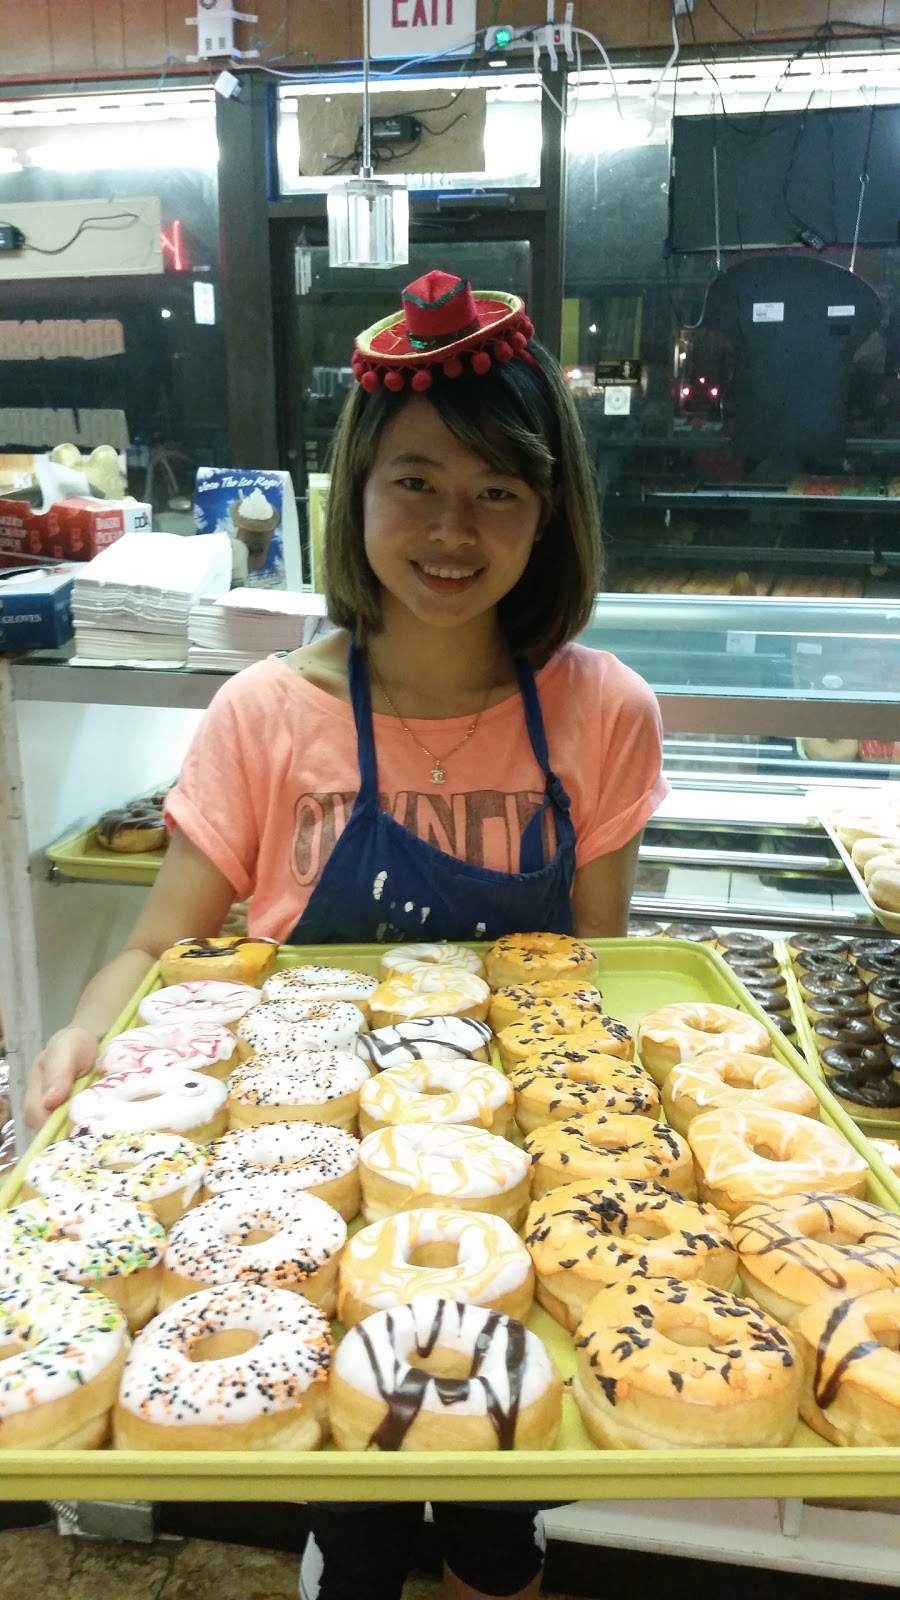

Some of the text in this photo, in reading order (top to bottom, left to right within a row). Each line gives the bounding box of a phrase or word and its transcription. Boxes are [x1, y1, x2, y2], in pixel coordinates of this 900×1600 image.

[221, 476, 239, 488] The
[238, 476, 254, 488] Ice
[1, 613, 43, 624] GLOVES
